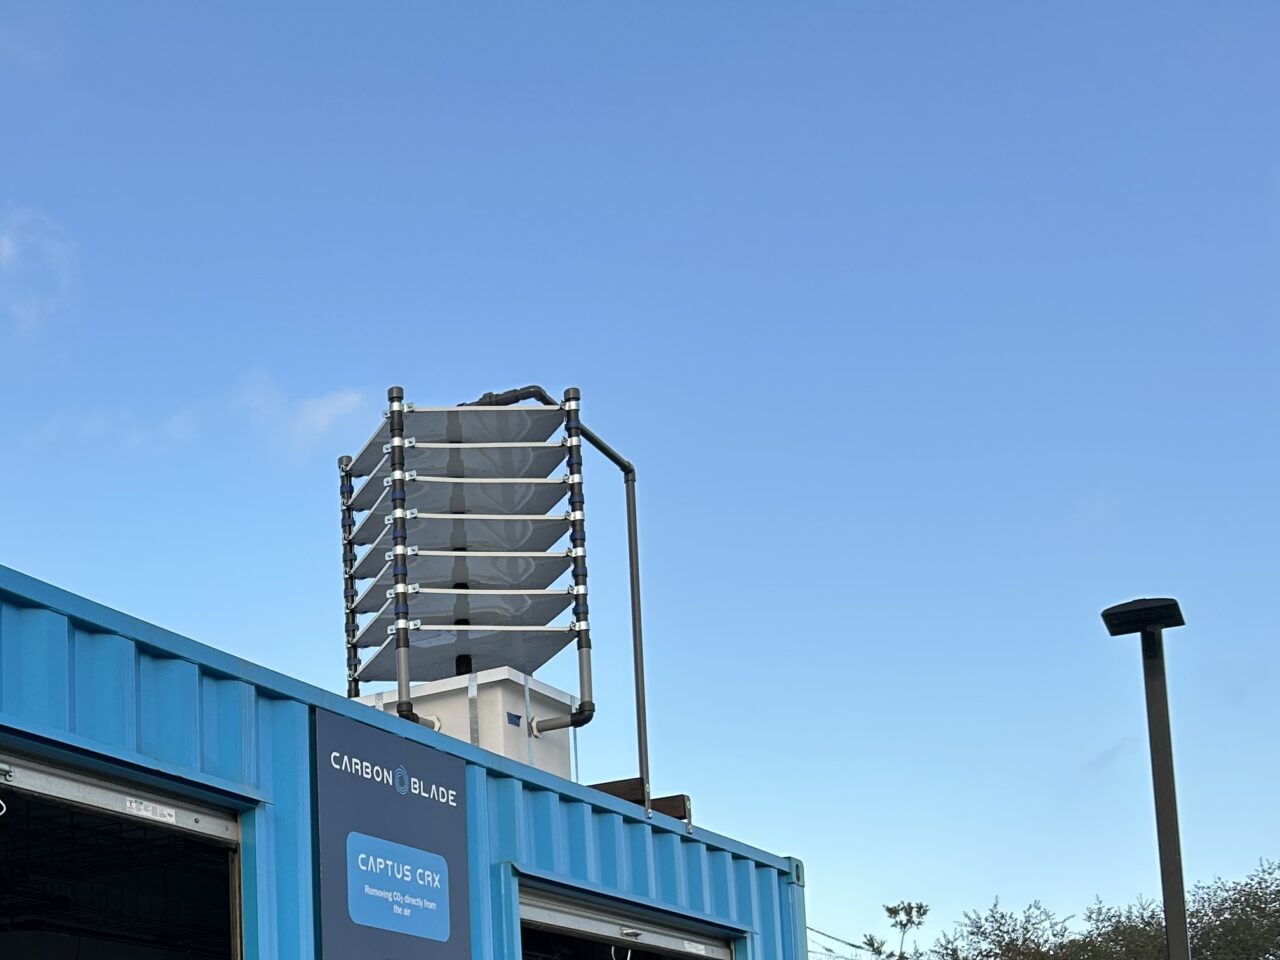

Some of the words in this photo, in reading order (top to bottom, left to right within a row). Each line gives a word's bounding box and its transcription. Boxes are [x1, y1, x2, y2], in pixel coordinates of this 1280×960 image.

[330, 751, 393, 786] CARBON
[410, 777, 457, 807] BLADE
[358, 853, 412, 881] CAPTUS
[416, 868, 441, 889] CRX
[364, 885, 393, 901] Removing
[404, 894, 423, 909] directly
[424, 898, 437, 910] from
[393, 904, 403, 915] the
